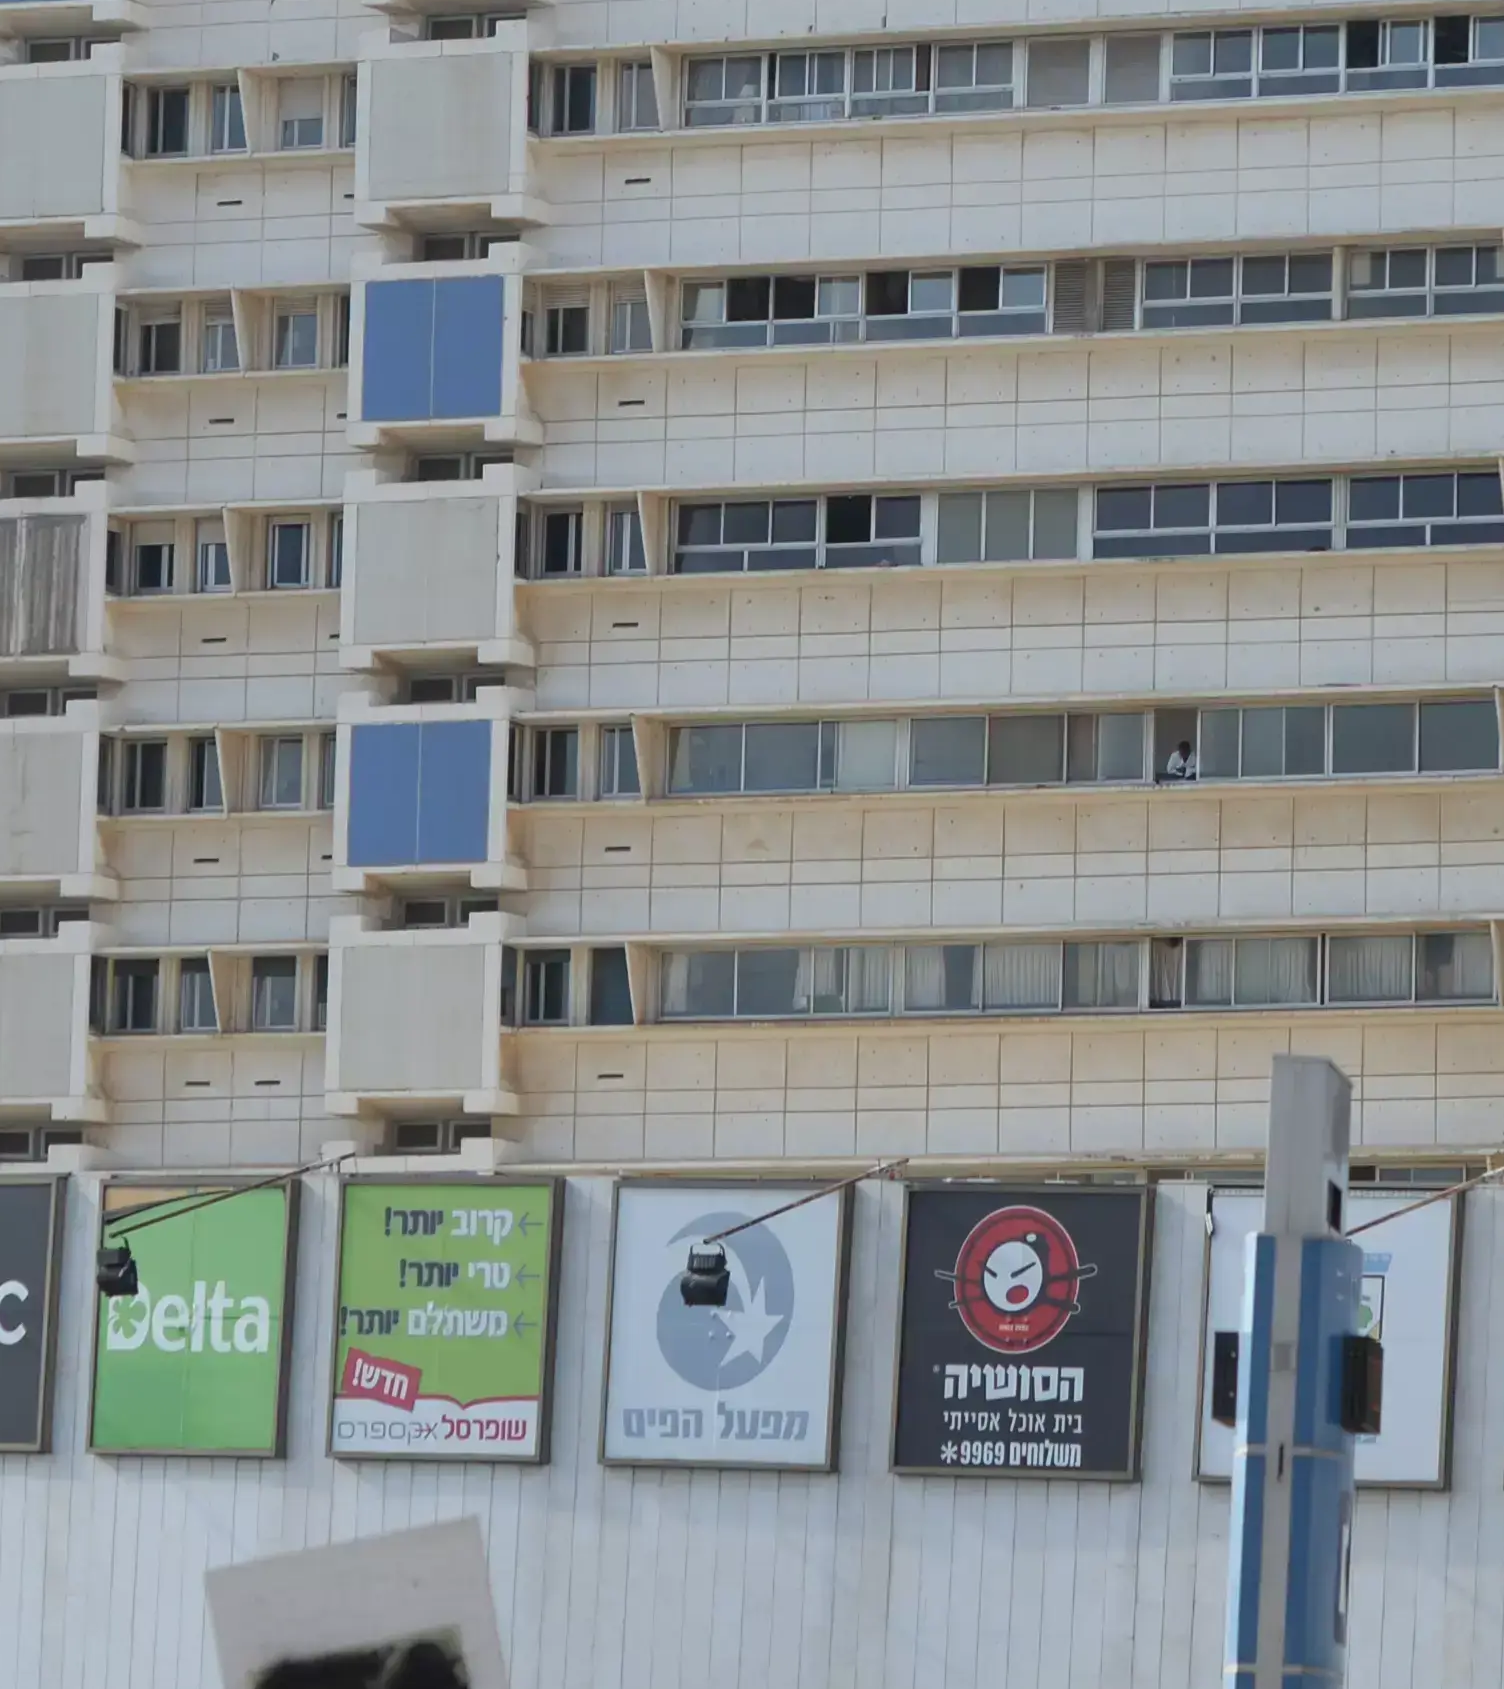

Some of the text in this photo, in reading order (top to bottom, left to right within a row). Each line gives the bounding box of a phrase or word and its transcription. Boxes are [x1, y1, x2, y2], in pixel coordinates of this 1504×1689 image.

[385, 1206, 514, 1245] קרוב יותר!
[399, 1258, 511, 1289] טרי יותר!
[107, 1280, 270, 1353] Delta
[340, 1300, 508, 1337] משתלם יותר!
[352, 1357, 409, 1400] חדש!
[944, 1363, 1084, 1403] הסושיה
[441, 1414, 527, 1441] שופרסל
[623, 1404, 809, 1442] מפעל הפיס
[943, 1408, 1083, 1434] בית אוכל אסייתי
[1009, 1438, 1081, 1468] משלוחים
